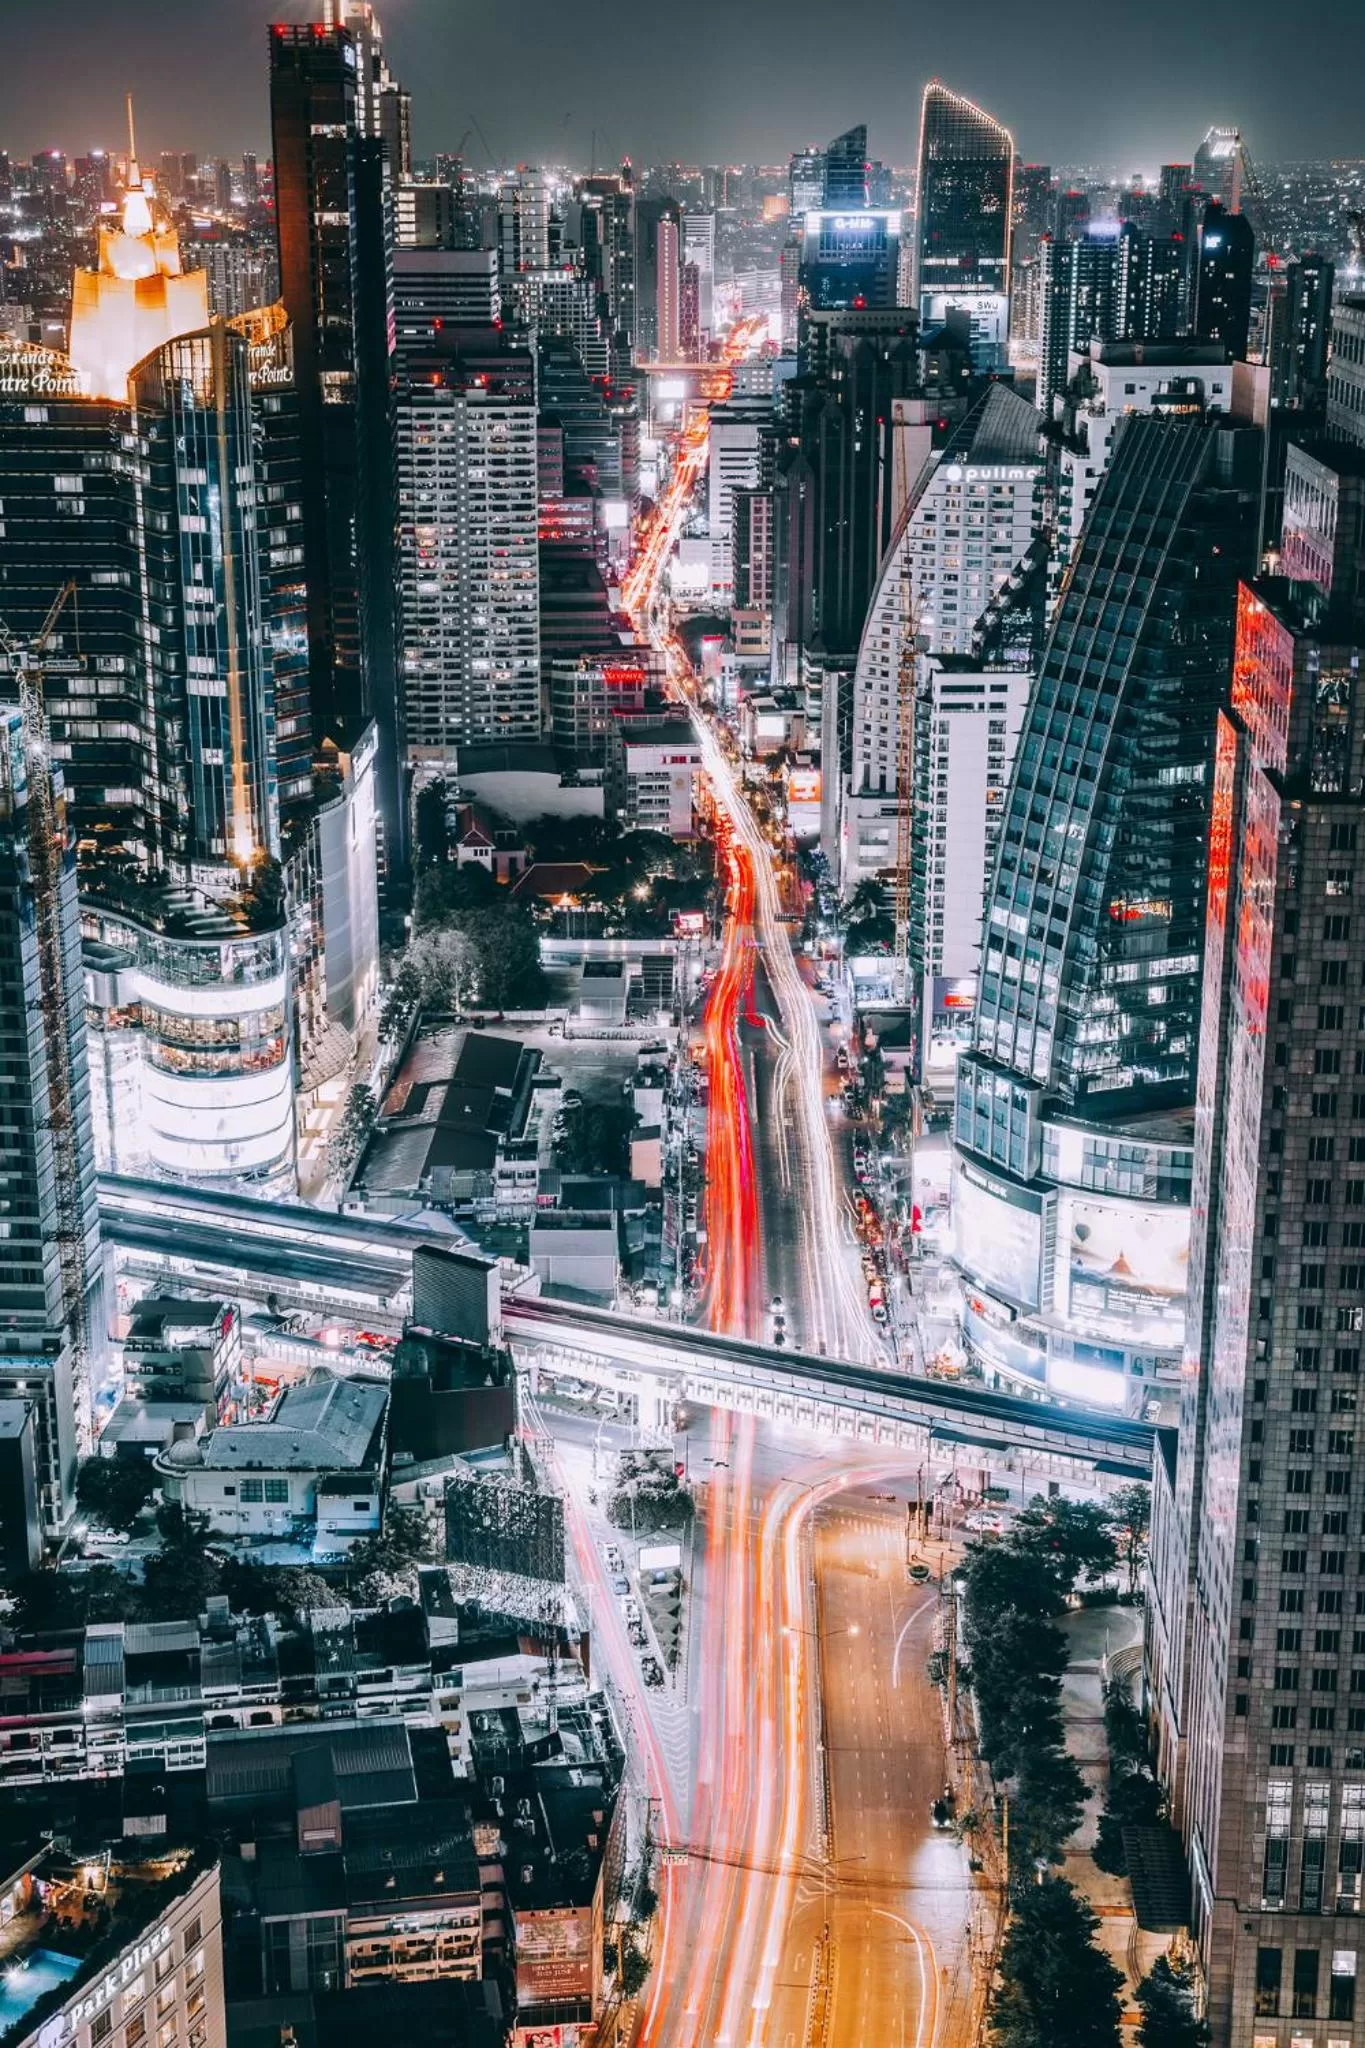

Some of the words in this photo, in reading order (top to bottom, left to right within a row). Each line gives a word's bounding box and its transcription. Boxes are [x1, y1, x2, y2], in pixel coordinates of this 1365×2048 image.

[258, 359, 293, 384] Point
[70, 1974, 119, 2032] Park
[121, 1925, 171, 1983] Plaza
